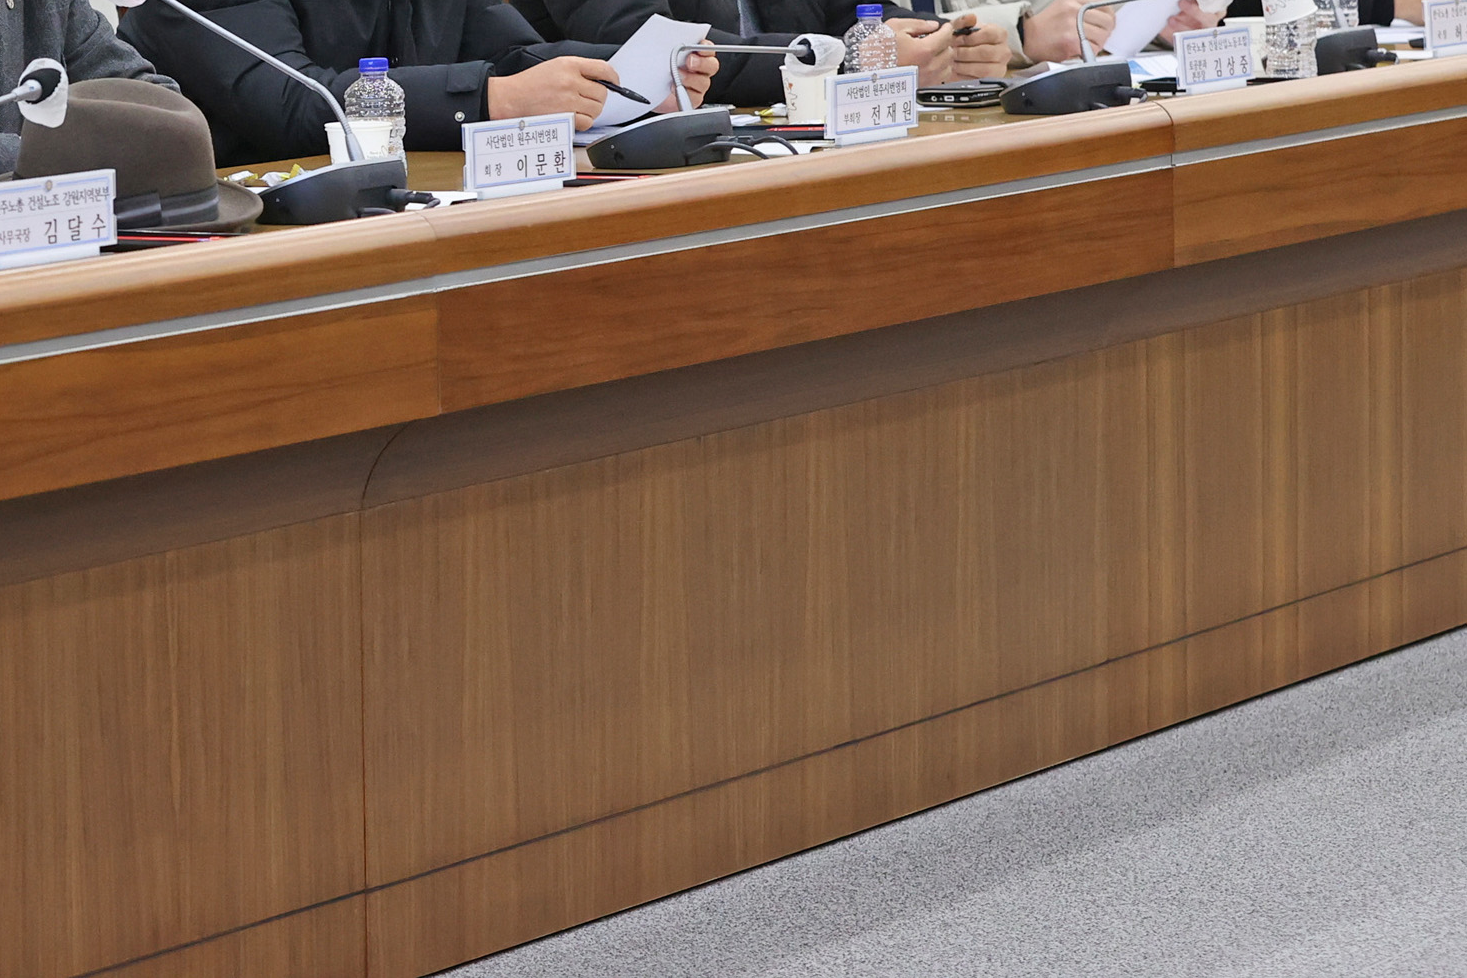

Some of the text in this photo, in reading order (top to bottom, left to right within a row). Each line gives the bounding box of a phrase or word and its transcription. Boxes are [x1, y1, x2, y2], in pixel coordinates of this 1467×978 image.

[847, 80, 907, 99] 사단법인 원주시번영회
[486, 128, 558, 149] 사단법인 원주시번영회
[27, 194, 61, 210] 건설노조
[62, 186, 110, 207] 강원지역본부
